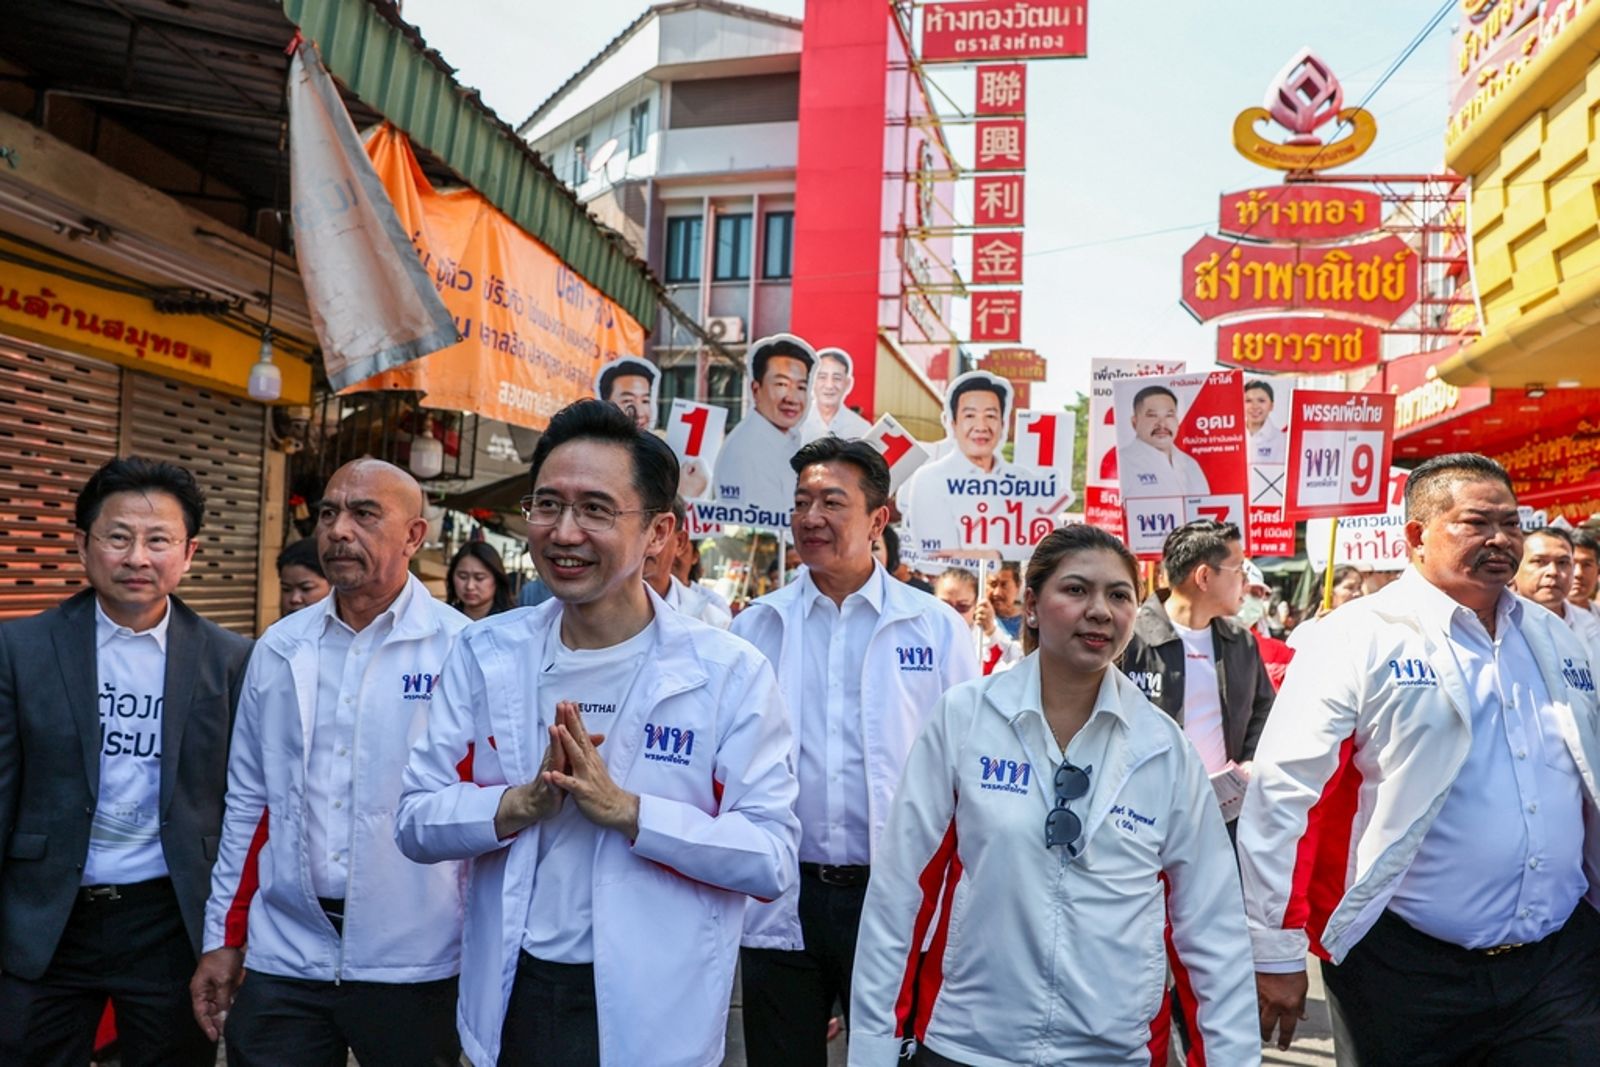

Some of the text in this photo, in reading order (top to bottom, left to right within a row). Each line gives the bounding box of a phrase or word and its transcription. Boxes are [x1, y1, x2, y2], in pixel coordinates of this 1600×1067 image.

[976, 72, 1022, 336] 聯興利金行
[1235, 190, 1366, 226] ห้างทอง
[1194, 246, 1412, 302] สง่าพาณิชย์
[1231, 327, 1365, 362] เยาวราช
[1196, 414, 1235, 436] อุดม
[1302, 395, 1384, 423] พรรคเพื่อไทย
[680, 402, 709, 457] 1
[1027, 414, 1057, 467] 1
[1304, 448, 1340, 478] พท
[1350, 443, 1375, 497] 9
[1137, 512, 1175, 532] พท
[896, 646, 933, 665] พท
[1388, 658, 1436, 679] พท
[1128, 671, 1162, 691] พท
[644, 722, 695, 756] พท
[980, 756, 1030, 786] พท
